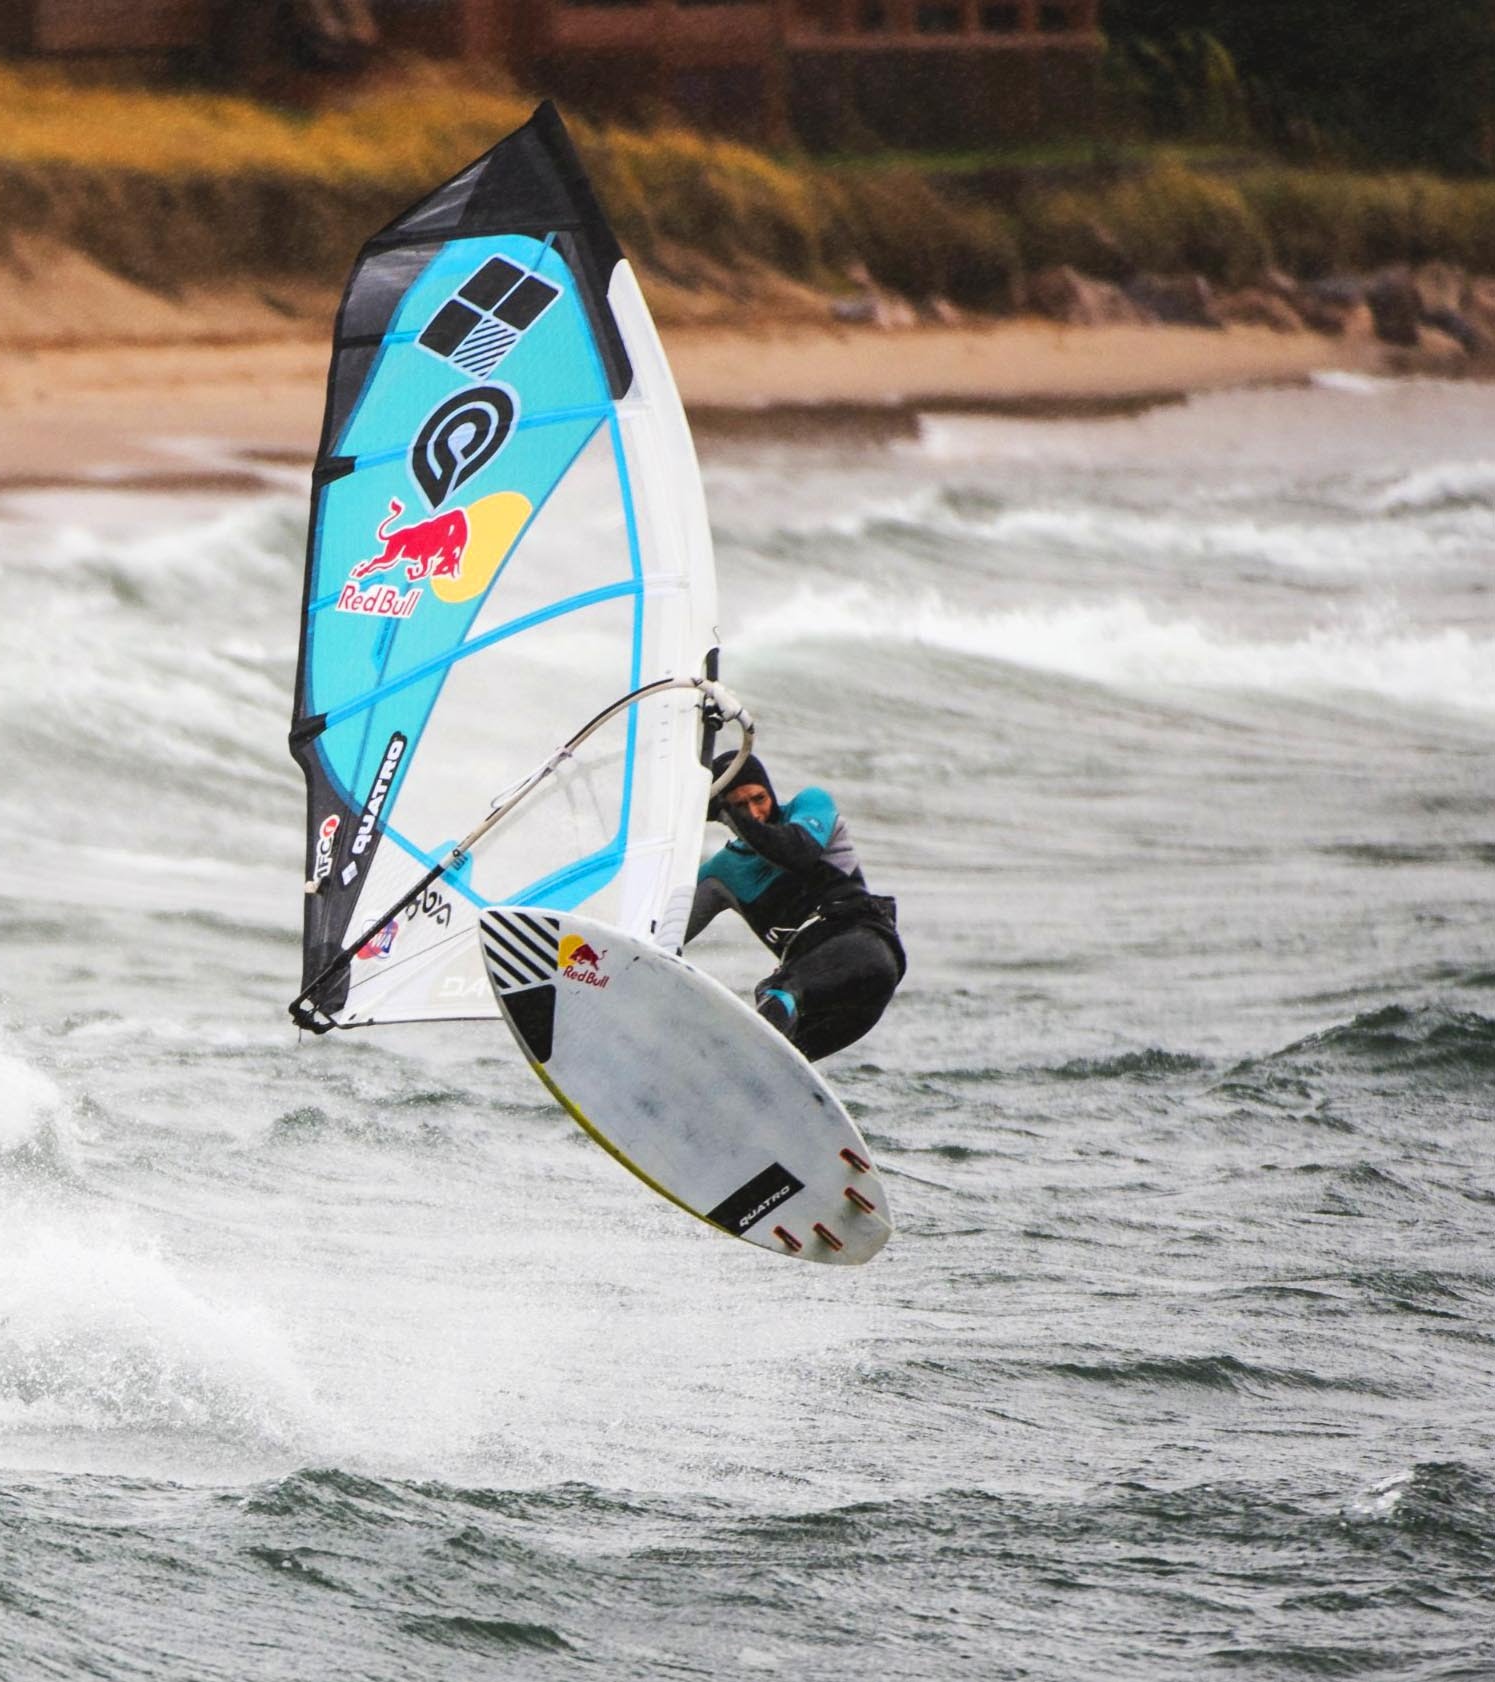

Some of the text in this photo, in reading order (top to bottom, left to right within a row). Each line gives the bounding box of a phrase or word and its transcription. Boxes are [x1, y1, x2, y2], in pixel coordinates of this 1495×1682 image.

[337, 584, 421, 616] Red Bull
[351, 740, 404, 855] QUATRO
[563, 965, 610, 988] Red Bull
[739, 1185, 790, 1227] QUATRO
